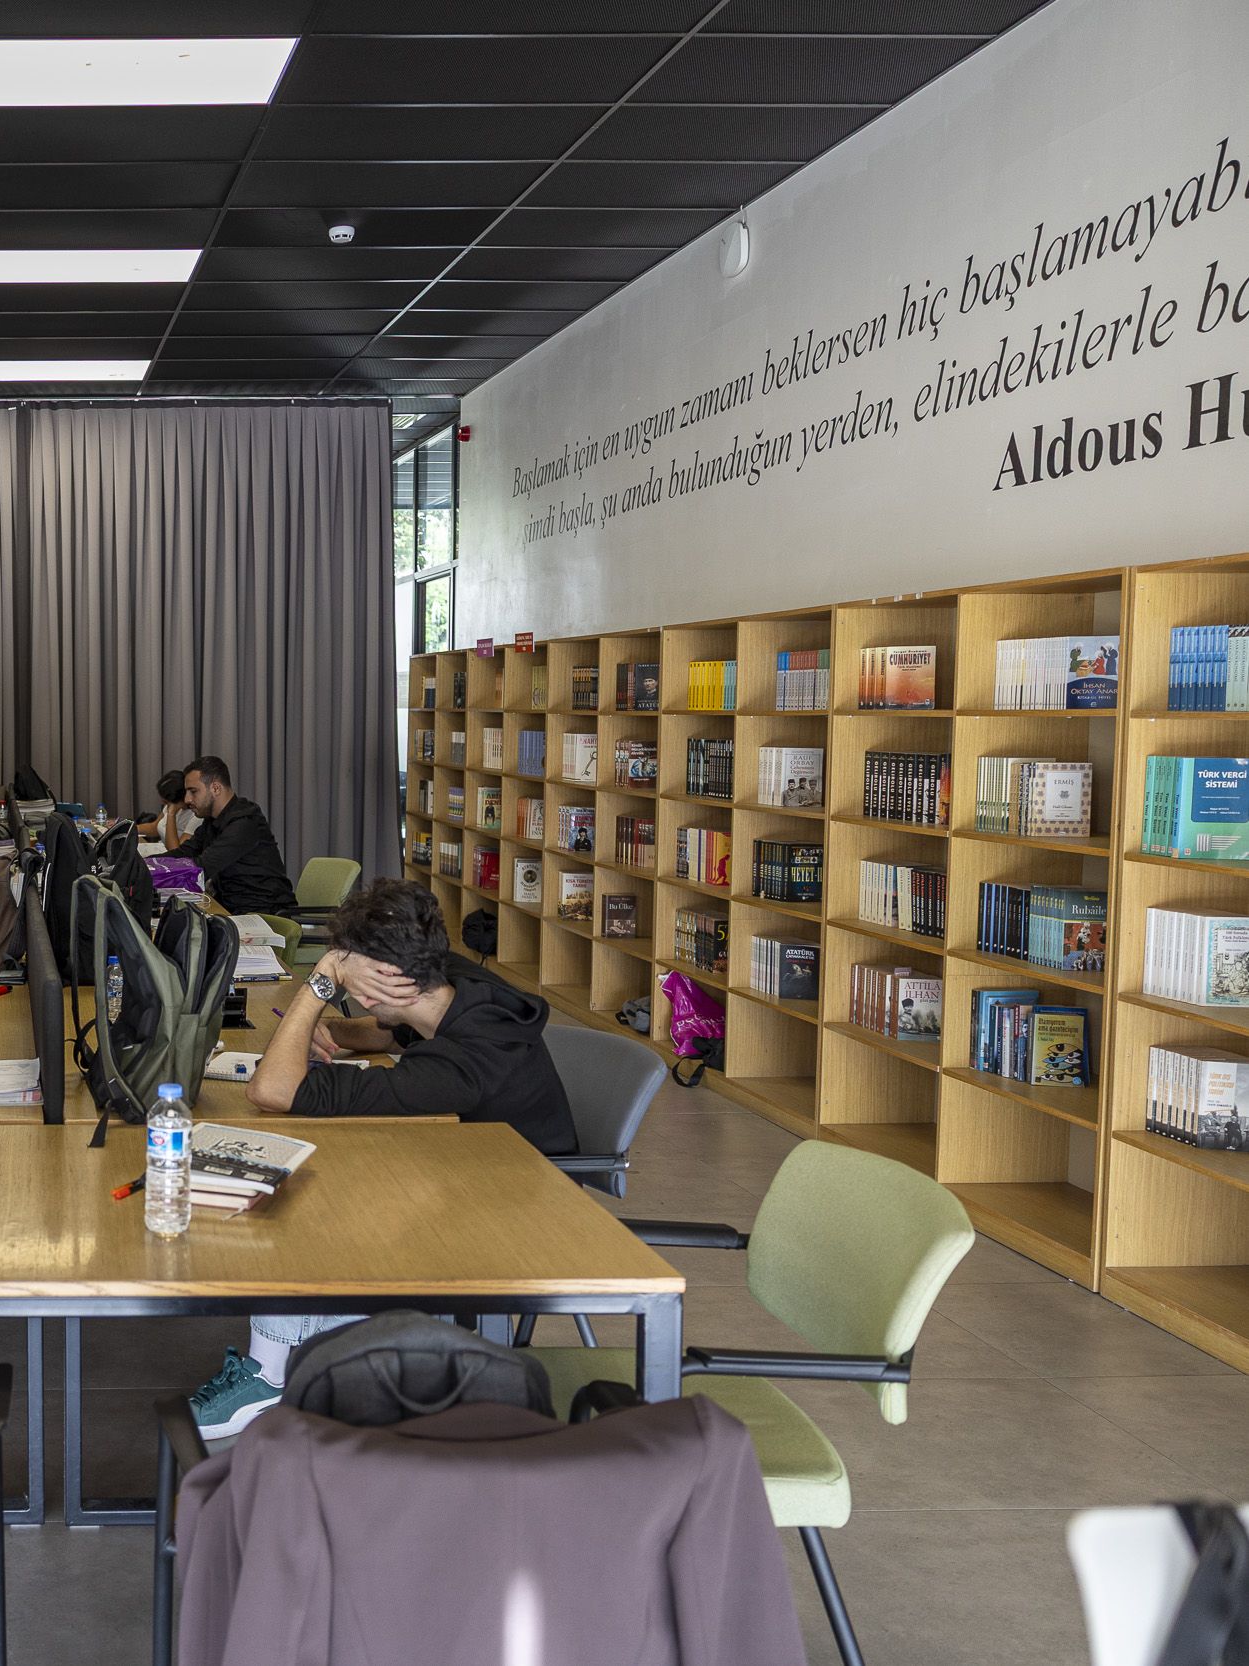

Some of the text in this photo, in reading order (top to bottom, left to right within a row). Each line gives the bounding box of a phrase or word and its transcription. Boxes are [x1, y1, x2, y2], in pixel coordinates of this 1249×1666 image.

[513, 136, 1249, 500] Başlamak için en uygun zamanı beklersen hiç başlamayab
[522, 504, 556, 552] şimdi
[558, 492, 596, 539] başla,
[600, 492, 618, 530] şu
[621, 465, 663, 514] anda
[667, 428, 793, 499] bulunduğun
[796, 389, 899, 474] yerden,
[913, 283, 1179, 423] elindekilerle
[991, 371, 1249, 492] Aldous H
[889, 652, 931, 666] CUMHURİYET
[1096, 687, 1119, 695] ANAR
[1197, 769, 1247, 778] TÜRK VERGİ
[1054, 778, 1075, 786] ERMİŞ
[1205, 779, 1238, 788] SİSTEMİ
[785, 949, 815, 957] ATATÜRK
